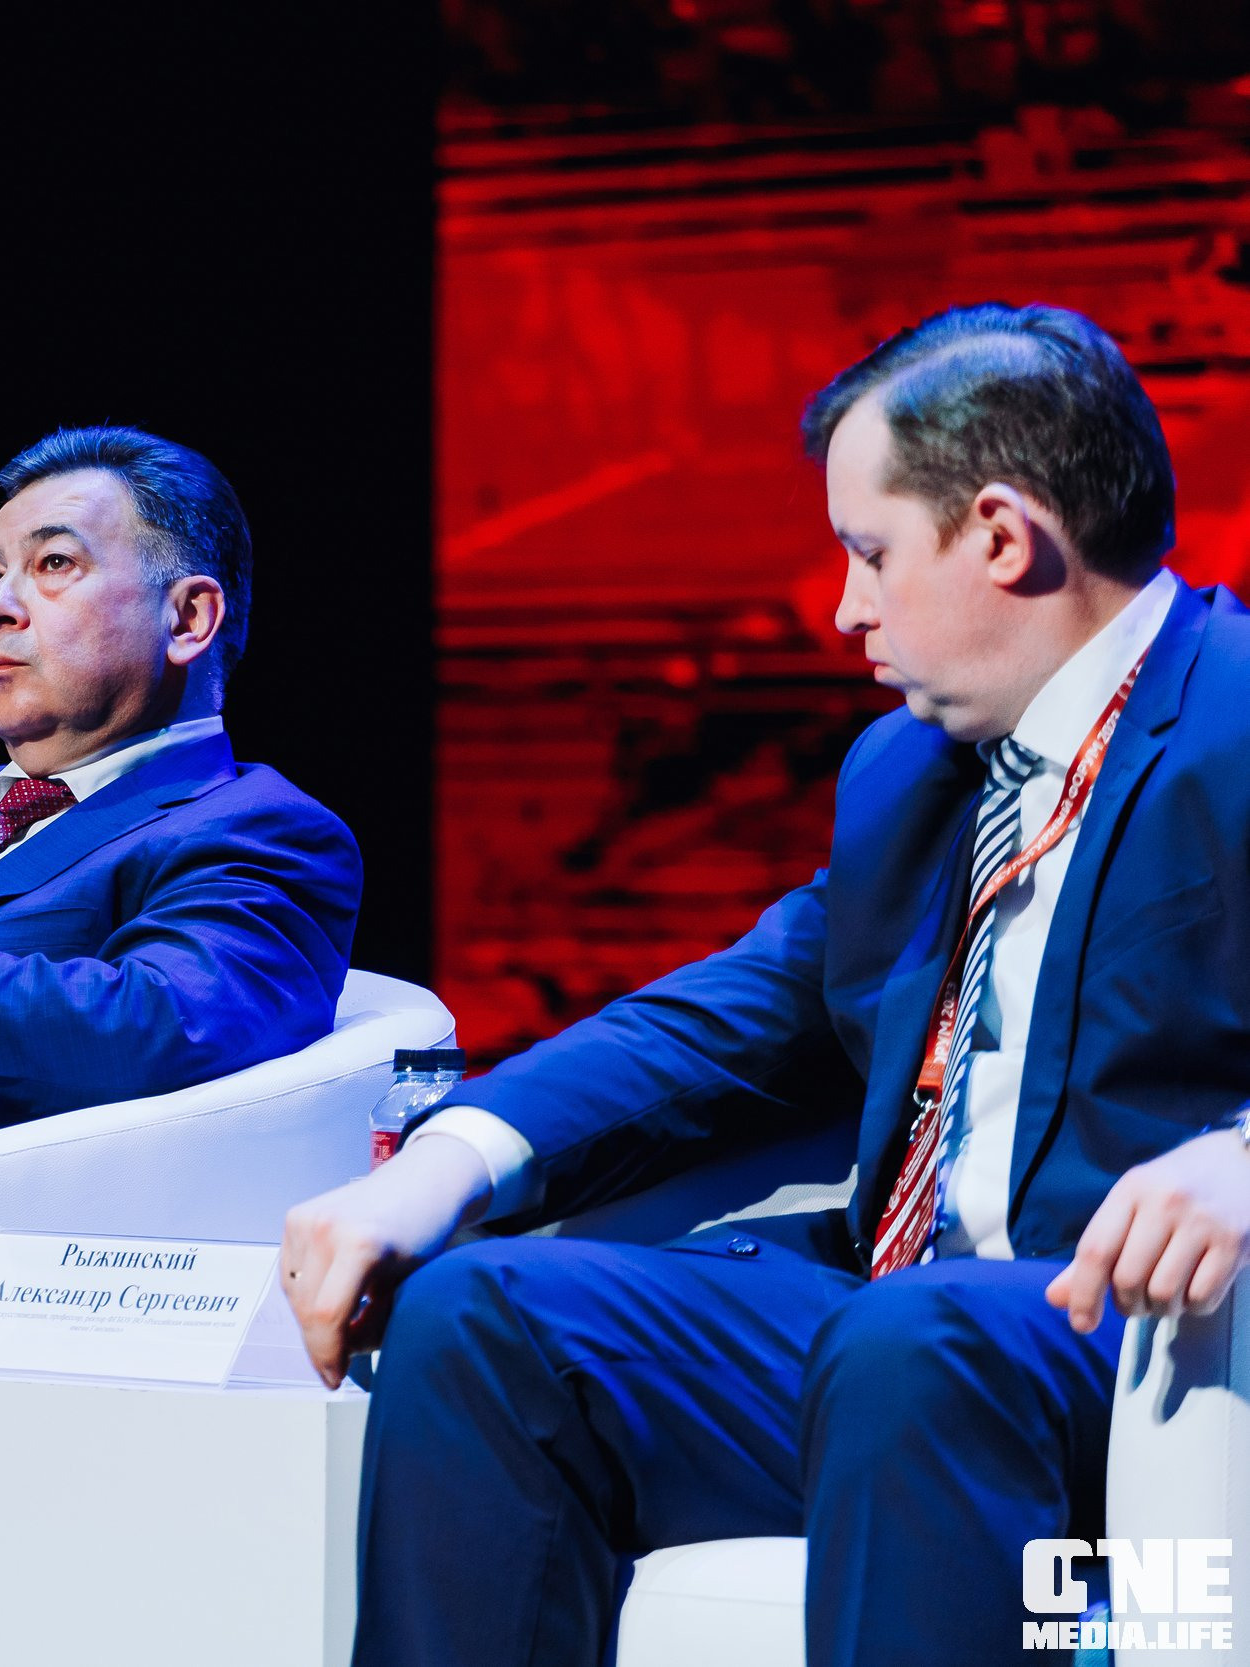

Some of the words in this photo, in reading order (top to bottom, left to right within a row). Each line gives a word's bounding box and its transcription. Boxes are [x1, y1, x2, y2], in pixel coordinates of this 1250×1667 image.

[1068, 739, 1102, 800] ФОРУМ
[59, 1243, 199, 1271] Рыжинский
[118, 1284, 240, 1316] Сергеевич
